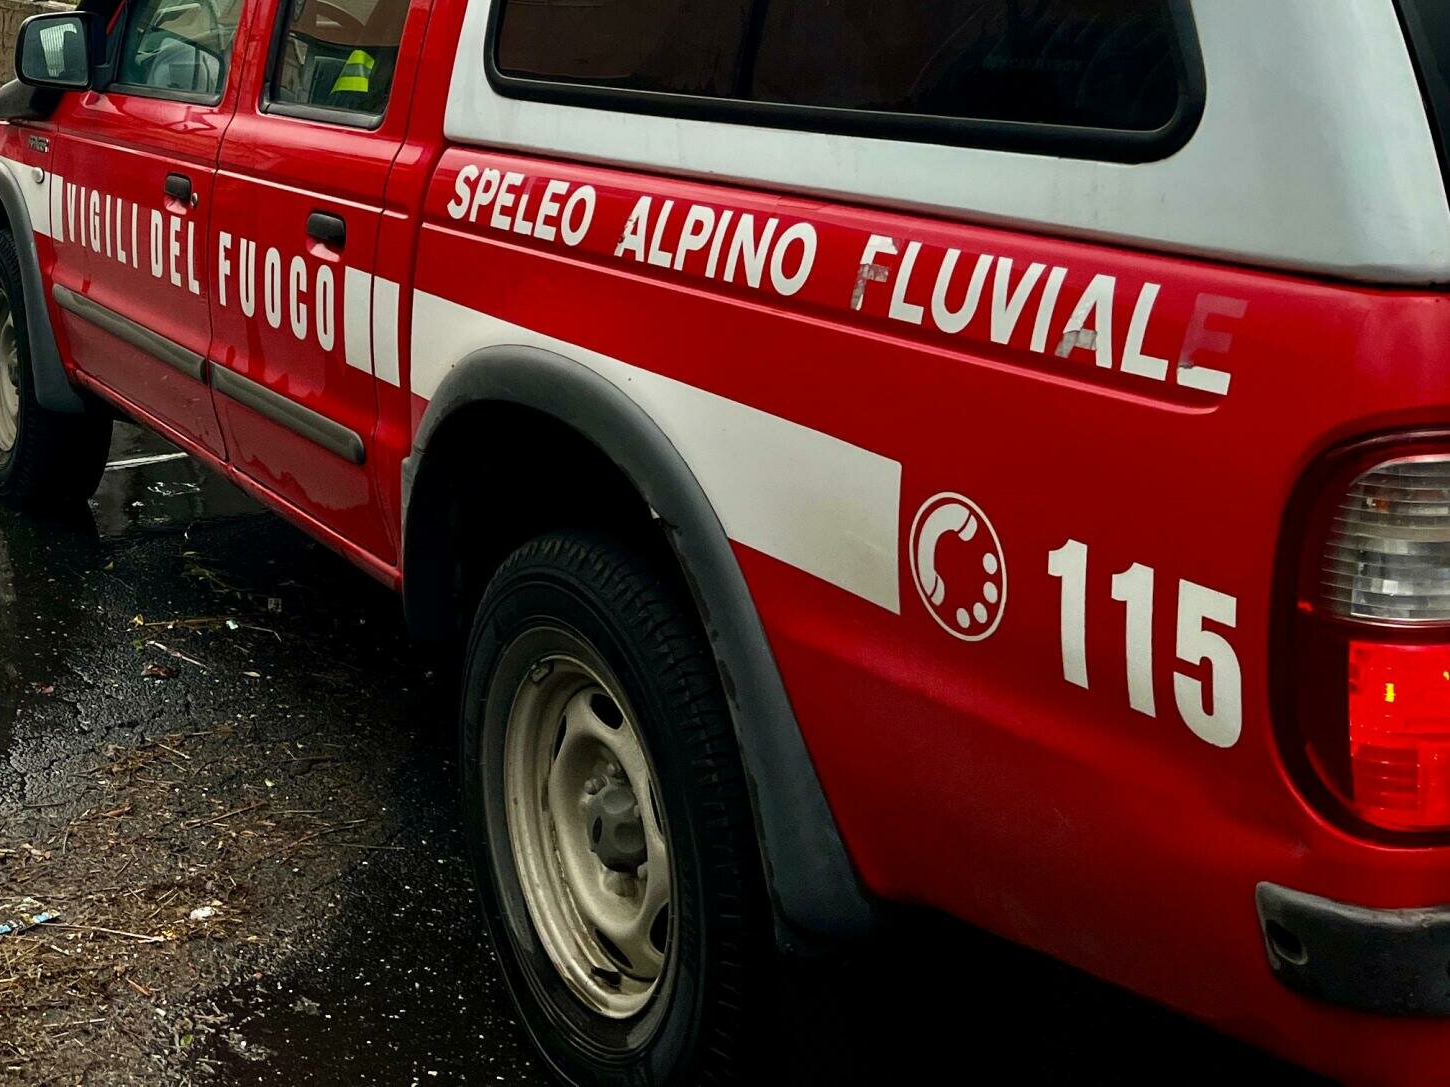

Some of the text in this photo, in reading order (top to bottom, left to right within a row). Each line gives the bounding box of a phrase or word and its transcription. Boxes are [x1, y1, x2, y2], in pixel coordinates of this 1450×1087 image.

[66, 182, 335, 352] VIGILI DEL FUOCO
[447, 164, 597, 246] SPELEO
[615, 196, 818, 296] ALPINO
[1048, 538, 1243, 748] 115
